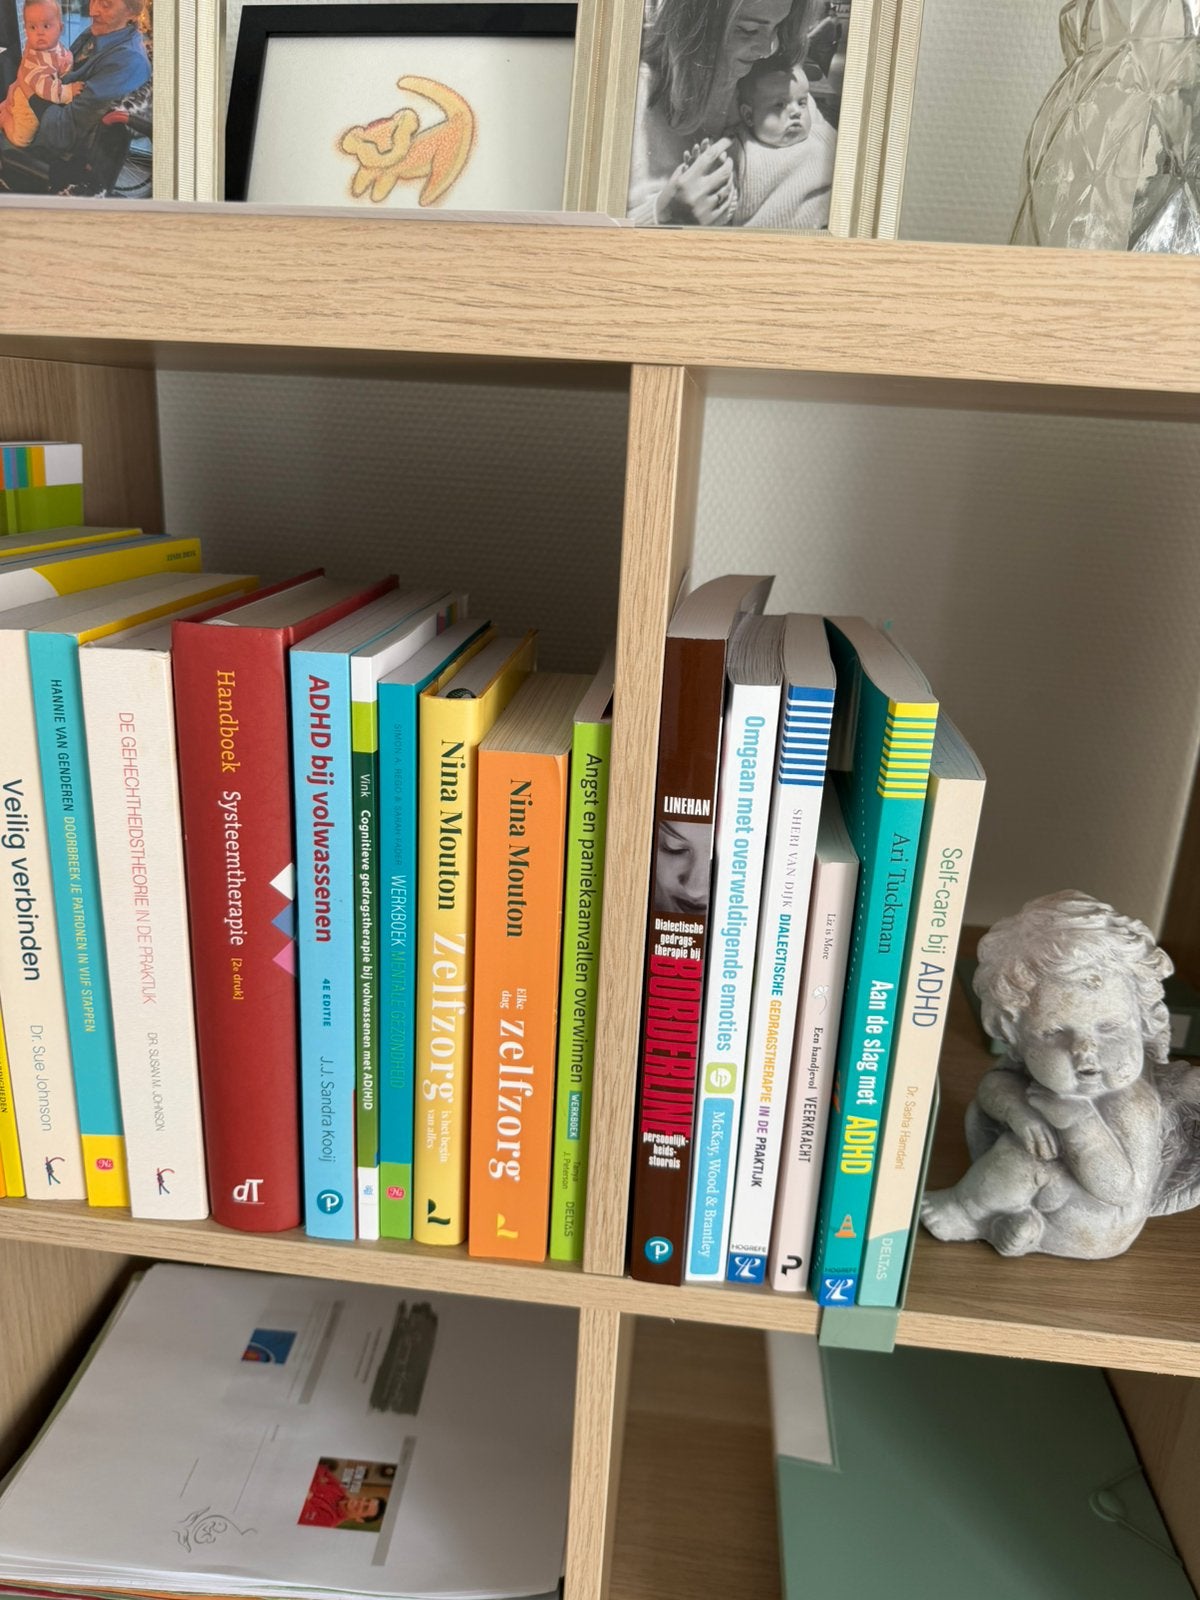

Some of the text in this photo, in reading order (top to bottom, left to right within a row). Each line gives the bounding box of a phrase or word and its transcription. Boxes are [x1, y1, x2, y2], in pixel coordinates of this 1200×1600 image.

[51, 679, 75, 812] HANNIE VAN GENDEREN
[217, 670, 242, 773] Handboek
[119, 712, 156, 1005] DE GEHECHTHEIDSTHEORIE IN DE PRAKTIJK
[306, 674, 335, 943] ADHD bij volwassenen
[438, 739, 466, 911] Nina Mouton
[506, 779, 533, 938] Nina Mouton
[664, 795, 711, 816] LINEHAN
[782, 808, 804, 909] SHERI VAN DIJK
[2, 778, 42, 982] Veilig verbinden
[218, 791, 248, 946] Systeemtherapie
[571, 753, 603, 1083] Angst en paniekaanvallen overwinnen
[716, 715, 766, 1051] Omgaan met overweldigende emoties
[877, 832, 911, 955] Ari Tuckman
[64, 816, 97, 1033] DOORBREEK JE PATRONEN IN VIJF STAPPEN
[358, 773, 374, 1110] Vink Cognitieve gedragstherapie bij volwassenen met AD(H)D
[654, 917, 705, 935] Dialectische
[654, 943, 702, 962] therapie bij
[660, 932, 697, 948] gedrags-
[822, 913, 837, 961] Liz is More
[911, 847, 963, 1028] Self-care bij ADHD
[231, 974, 245, 1000] druk]
[321, 977, 332, 1028] 4E EDITIE
[389, 874, 407, 1089] WERKBOEK MENTALE GEZONDHEID
[422, 932, 468, 1103] Zelfzorg
[499, 990, 513, 1009] dag
[516, 987, 528, 1010] Elke
[30, 1024, 52, 1132] Dr. Sue Johnson
[488, 1018, 535, 1182] zelfzorg
[640, 954, 704, 1139] BORDERLINE
[750, 913, 792, 1188] DIALECTISCHE GEDRAGSTHERAPIE IN DE PRAKTIJK
[798, 1026, 824, 1163] Een handjevol VEERKRACHT
[839, 978, 895, 1175] Aan de slag met ADHD
[152, 1090, 166, 1132] JOHNSON
[318, 1055, 337, 1164] J.J. Sandra Kooij
[439, 1136, 452, 1162] begin
[440, 1120, 453, 1136] het
[569, 1093, 581, 1138] WERKBOEK
[642, 1131, 690, 1148] persoonlijk-
[652, 1143, 678, 1158] heids-
[894, 1085, 920, 1171] Dr. Sasha Hamdani
[562, 1159, 571, 1190] Peterson
[563, 1200, 575, 1237] DELTAS
[697, 1110, 726, 1259] McKay, Wood & Brantley
[731, 1242, 767, 1254] HOGREFE
[875, 1237, 894, 1281] DELTAS
